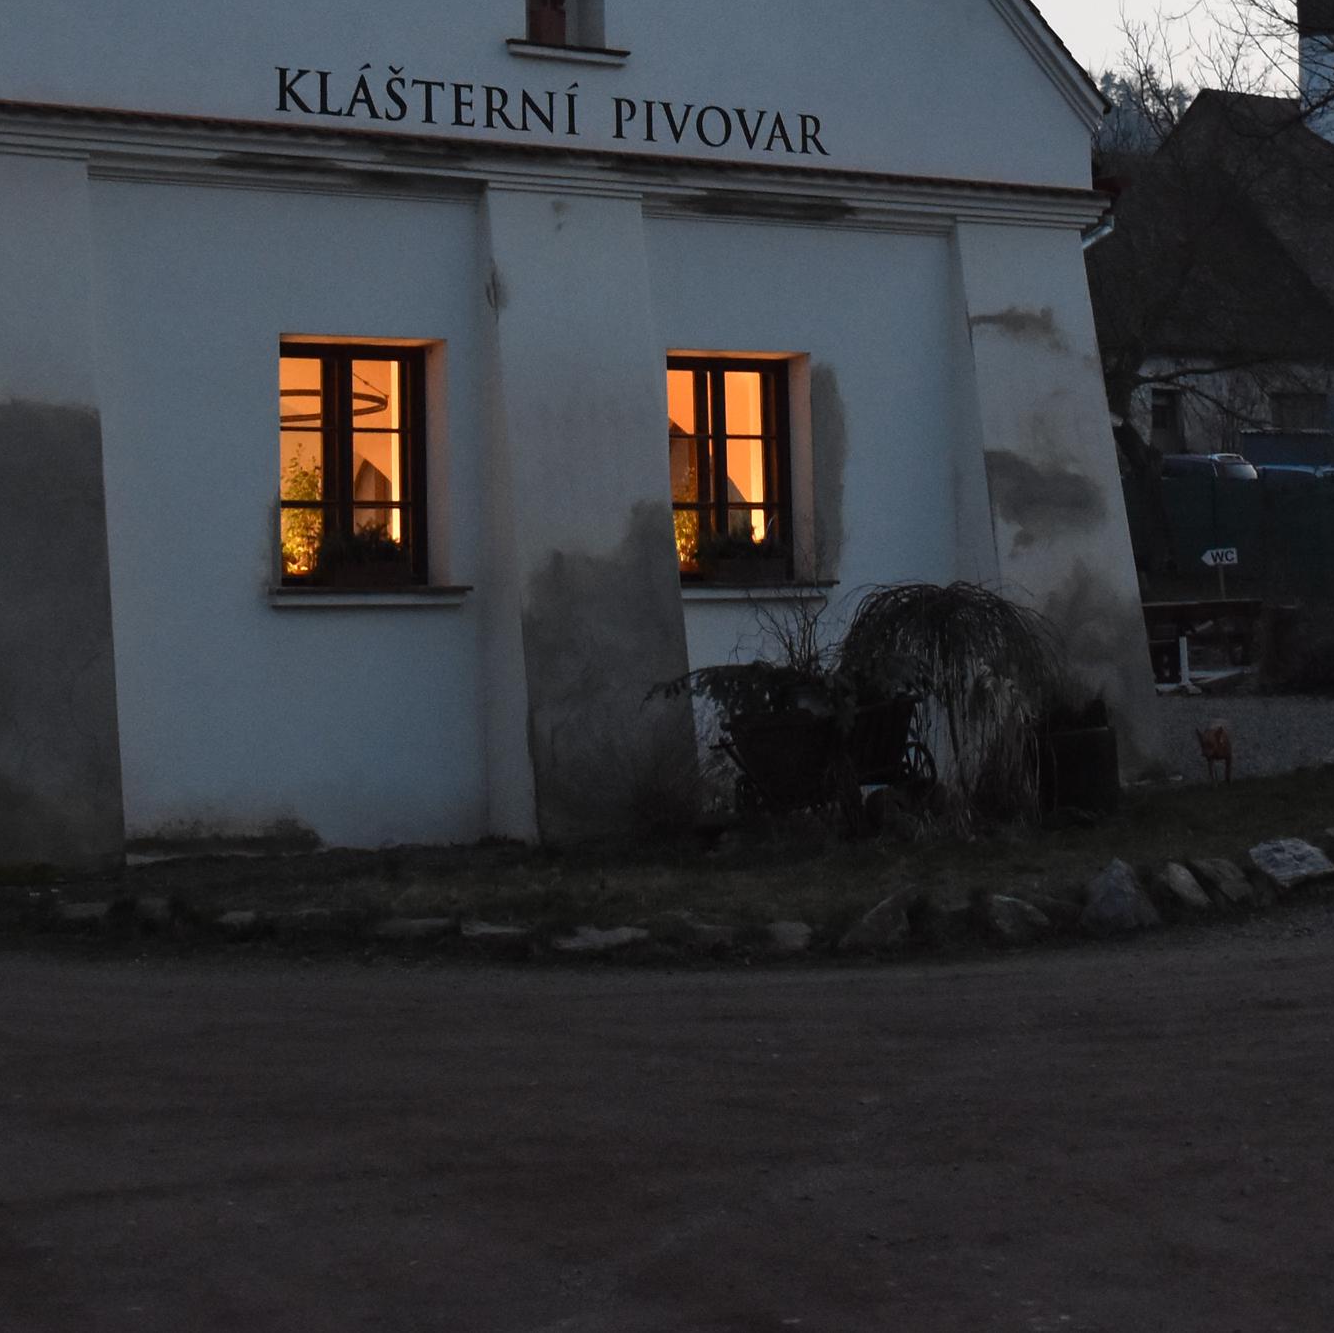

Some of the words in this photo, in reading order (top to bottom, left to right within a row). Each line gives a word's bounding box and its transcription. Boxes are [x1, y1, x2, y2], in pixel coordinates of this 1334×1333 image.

[274, 63, 581, 135] KLÁŠTERNÍ
[611, 96, 831, 156] PIVOVAR
[1210, 550, 1235, 562] WC
